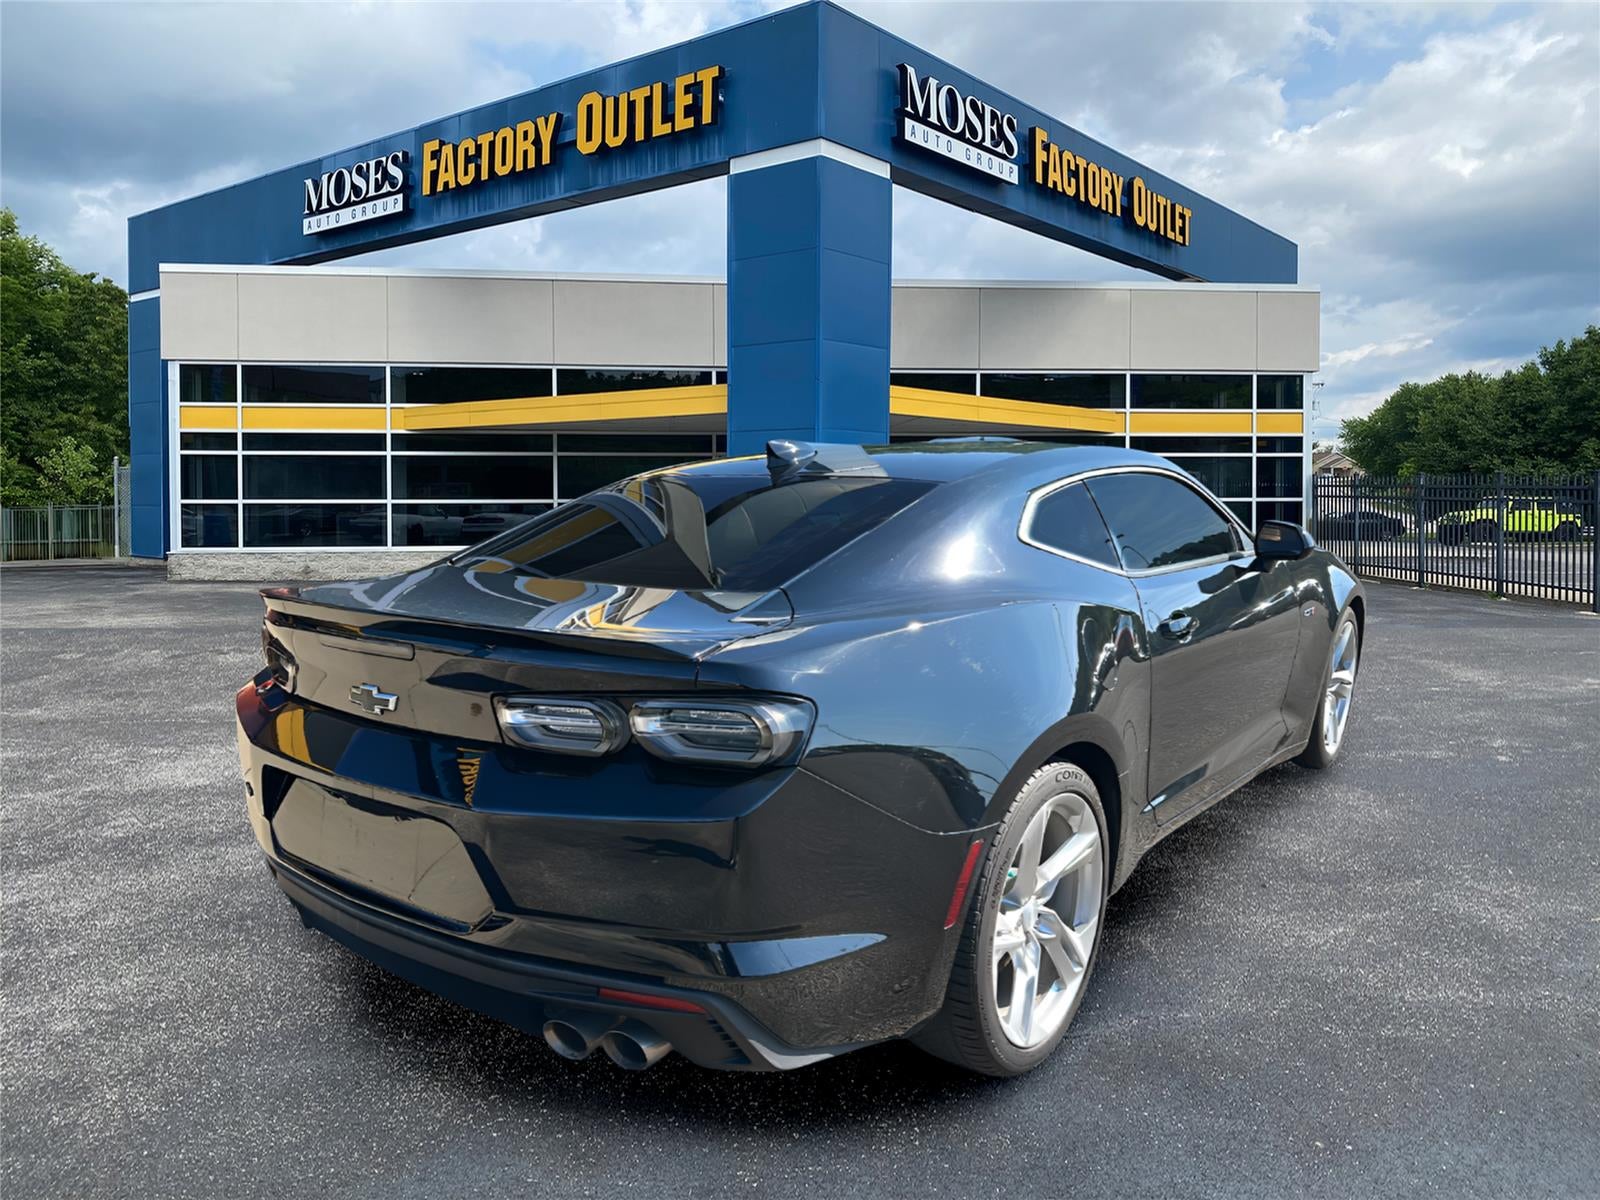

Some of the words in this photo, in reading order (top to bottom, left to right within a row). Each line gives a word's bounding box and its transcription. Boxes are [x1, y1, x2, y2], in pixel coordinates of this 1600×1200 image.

[422, 112, 559, 196] FACTORY
[576, 65, 720, 155] OUTLET
[904, 63, 1018, 160] MOSES
[910, 124, 953, 154] AUTO
[965, 149, 1015, 179] GROUP
[303, 151, 403, 214] MOSES
[307, 213, 341, 231] AUTO
[351, 198, 399, 220] GROUP
[1035, 127, 1124, 217] FACTORY
[1132, 176, 1192, 246] OUTLET
